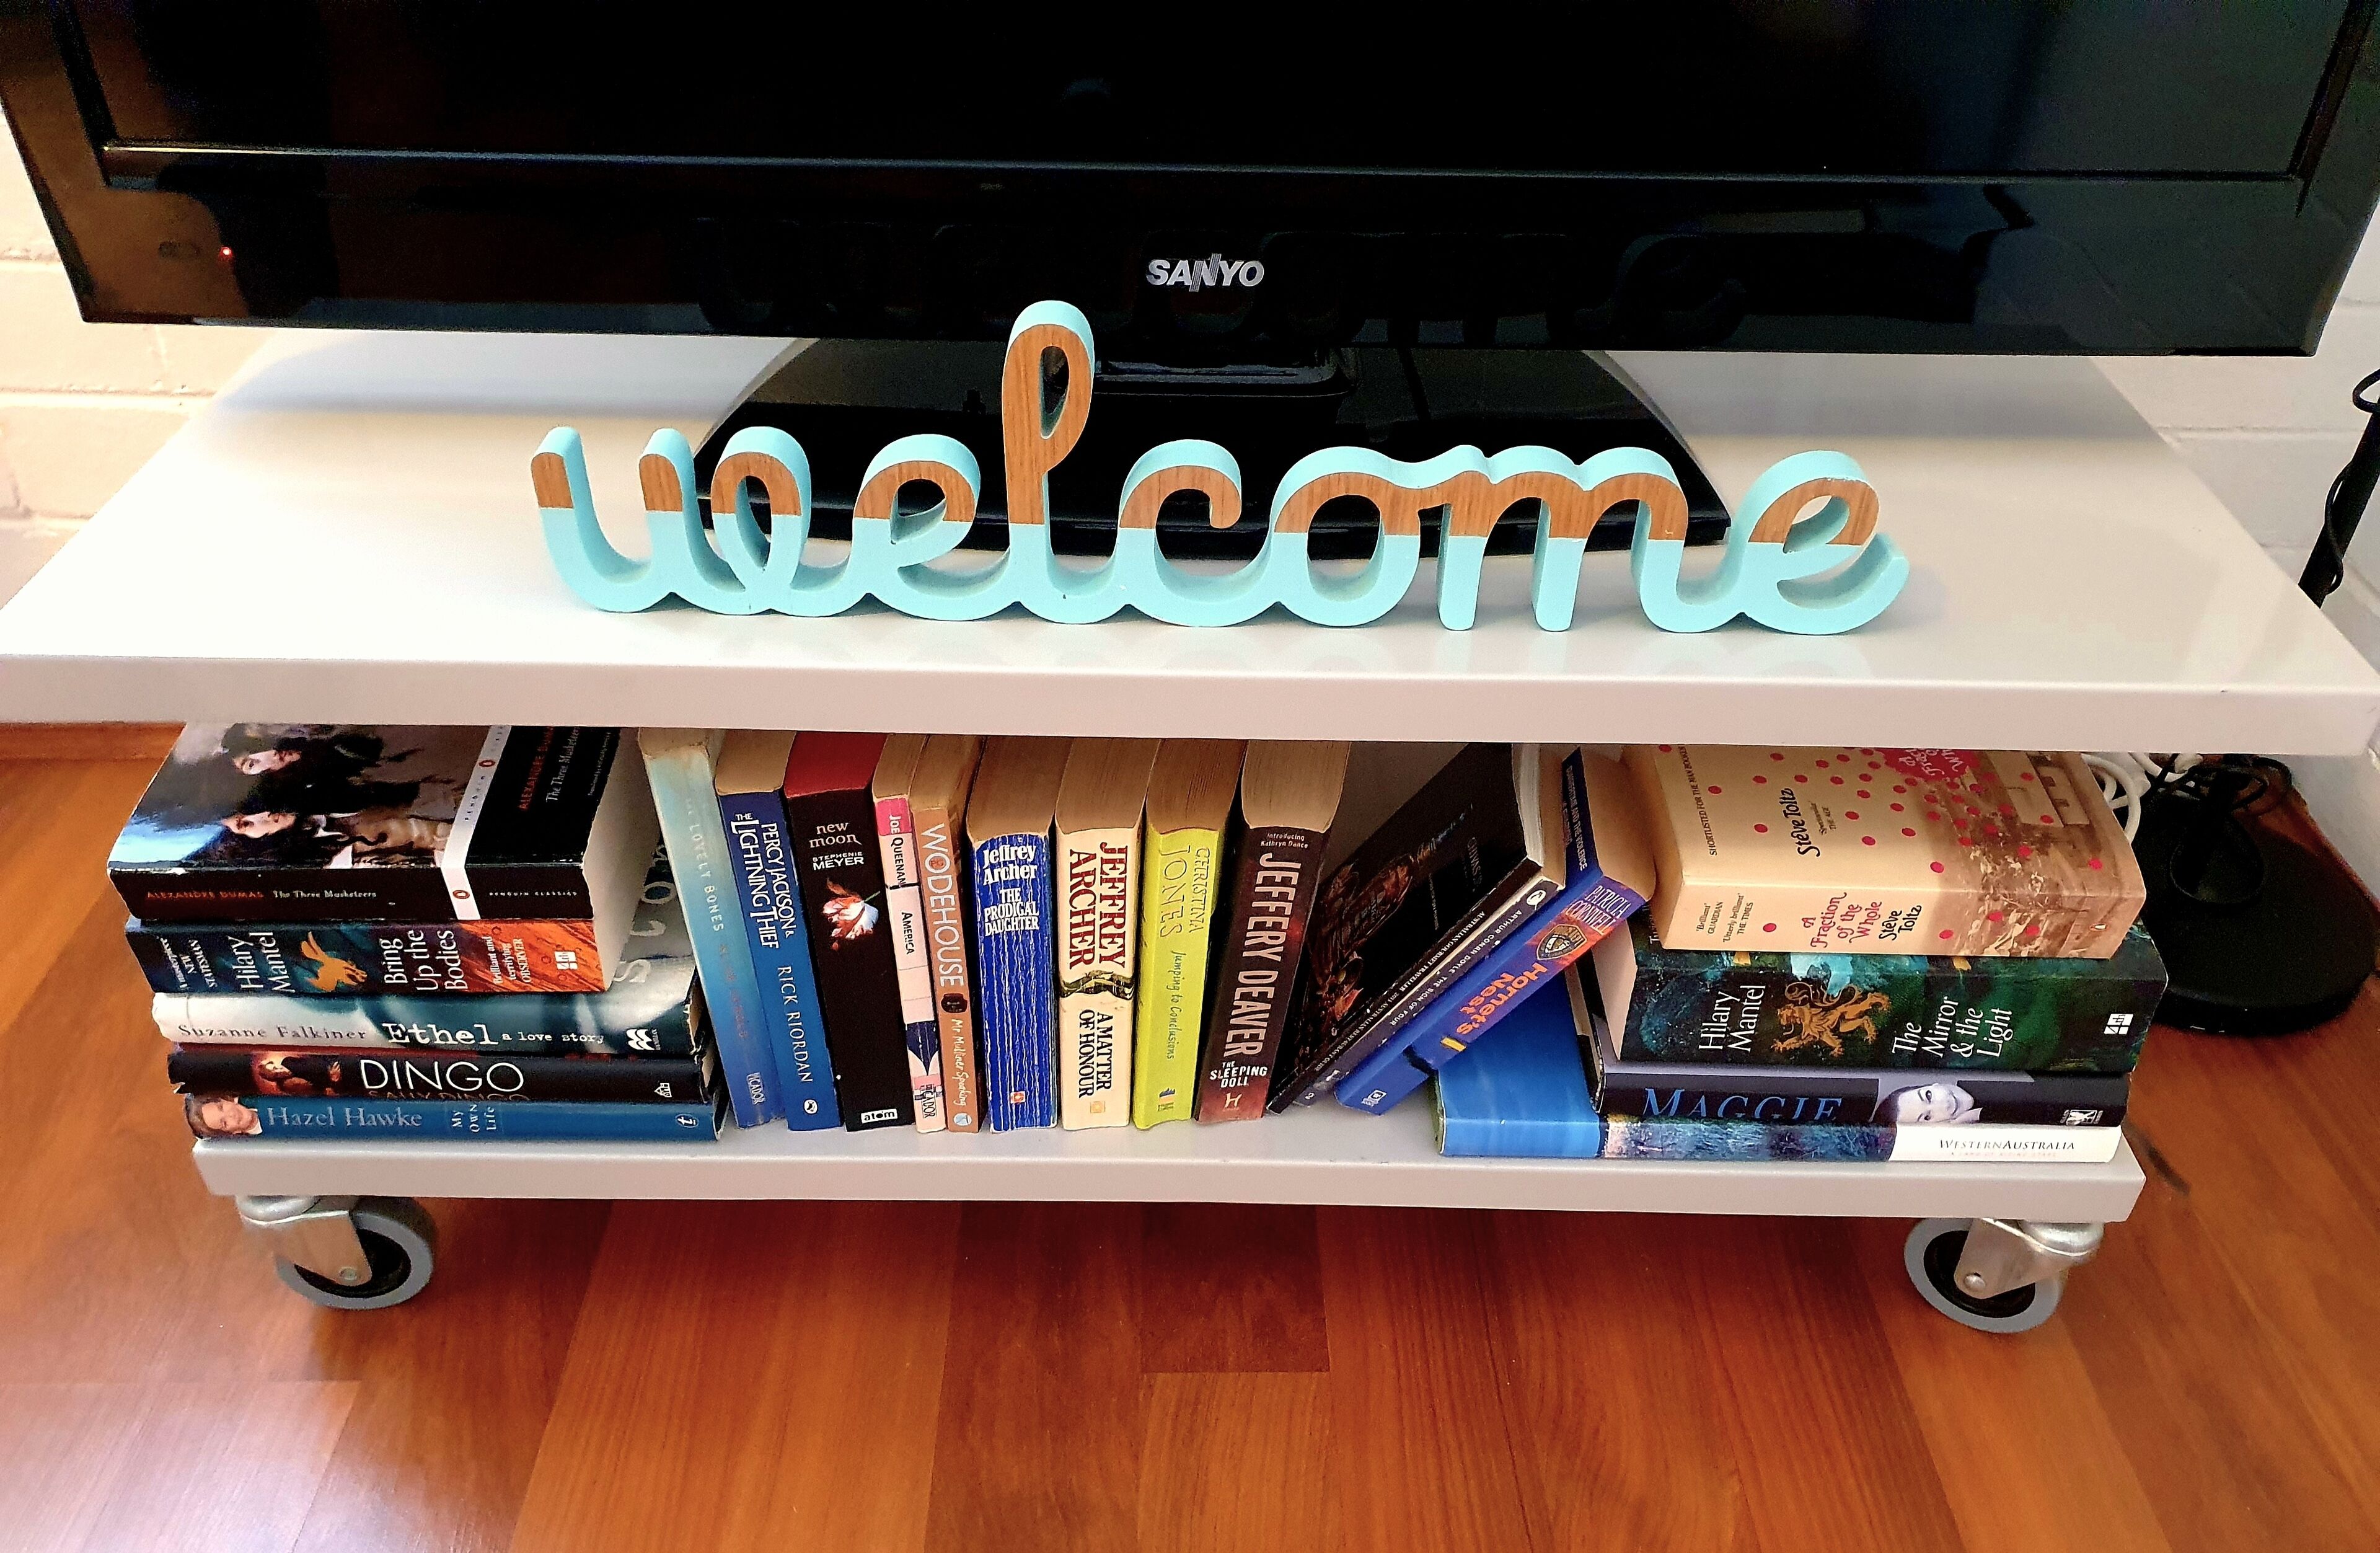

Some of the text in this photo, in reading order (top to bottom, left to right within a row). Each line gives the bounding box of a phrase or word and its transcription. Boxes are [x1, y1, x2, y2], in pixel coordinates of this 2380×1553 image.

[1146, 253, 1264, 292] SANYO
[529, 301, 1910, 636] welcome
[545, 787, 558, 803] The
[1690, 784, 1701, 796] THE
[1695, 797, 1704, 810] FOR
[735, 813, 754, 821] THE
[816, 822, 850, 835] new
[889, 814, 902, 834] JOE
[1698, 810, 1717, 856] SHORTLISTED
[1779, 787, 1821, 857] Steve Toltz
[809, 834, 863, 849] moon
[1260, 840, 1309, 849] Kathryn Dance
[1267, 833, 1305, 841] Introducing
[1575, 836, 1588, 872] VIOLENCE
[730, 818, 771, 908] LIGHTNING
[813, 851, 863, 862] STEPHENIE
[813, 857, 865, 870] MEYER
[983, 844, 1037, 869] Jeffrey
[983, 864, 1038, 885] Archer
[273, 890, 290, 899] The
[293, 890, 321, 899] Three
[761, 823, 796, 939] PERCY JACKSON &
[1000, 888, 1022, 904] THE
[1158, 844, 1191, 937] JONES
[1189, 847, 1210, 934] CHRISTINA
[703, 885, 724, 932] BONES
[920, 823, 964, 988] WODEHOUSE
[984, 901, 1039, 923] PRODIGAL
[1069, 849, 1097, 970] ARCHER
[1098, 841, 1129, 968] JEFFREY
[1565, 900, 1617, 936] CORNWELL
[1584, 885, 1632, 919] PATRICIA
[1708, 901, 1724, 934] GUARDIAN
[1737, 902, 1753, 935] THE TIMES
[1810, 892, 1848, 948] Fraction
[1897, 905, 1923, 934] Toltz
[749, 905, 779, 949] THIEF
[901, 911, 915, 955] AMERICA
[985, 915, 1039, 937] DAUGHTER
[1452, 911, 1486, 942] AUSTRALIAN
[1836, 904, 1862, 939] of the
[1848, 901, 1882, 944] Whole
[1879, 909, 1903, 941] Steve
[227, 935, 265, 989] Hilary
[249, 932, 296, 993] Mantel
[379, 938, 409, 984] Bring
[403, 930, 442, 991] Up the
[436, 930, 469, 990] Bodies
[481, 936, 504, 984] Brilliant and
[512, 938, 532, 983] OBSERVER
[1223, 852, 1302, 1058] JEFFERY DEAVER
[1390, 909, 1523, 1027] ARTHUR CONAN DOYLE THE SIGN OF FOUR
[1399, 964, 1429, 993] TRAVELLER
[1460, 973, 1515, 1014] Nest
[1166, 950, 1187, 1060] Jumping to Conclusions
[1457, 963, 1548, 1035] Hornet's
[178, 1024, 367, 1040] Suzanne Falkiner
[382, 1022, 606, 1045] Ethel a love story
[777, 965, 814, 1083] RICK RIORDAN
[1698, 991, 1740, 1050] Hilary
[1727, 985, 1766, 1053] Mantel
[1921, 996, 1959, 1058] Mirror
[1950, 1007, 1984, 1058] & the
[1976, 1007, 2014, 1058] Light
[1078, 1009, 1095, 1099] OF HONOUR
[1096, 1011, 1114, 1091] A MATTER
[1892, 1022, 1922, 1054] The
[359, 1059, 524, 1092] DINGO
[951, 1019, 972, 1107] Mr Mulliner Speaking
[1210, 1066, 1268, 1081] SLEEPING
[1222, 1060, 1235, 1068] THE
[1220, 1076, 1250, 1089] DOLL
[267, 1105, 423, 1127] Hazel Hawke
[863, 1110, 896, 1122] atom
[1642, 1087, 1843, 1122] MAGGIE
